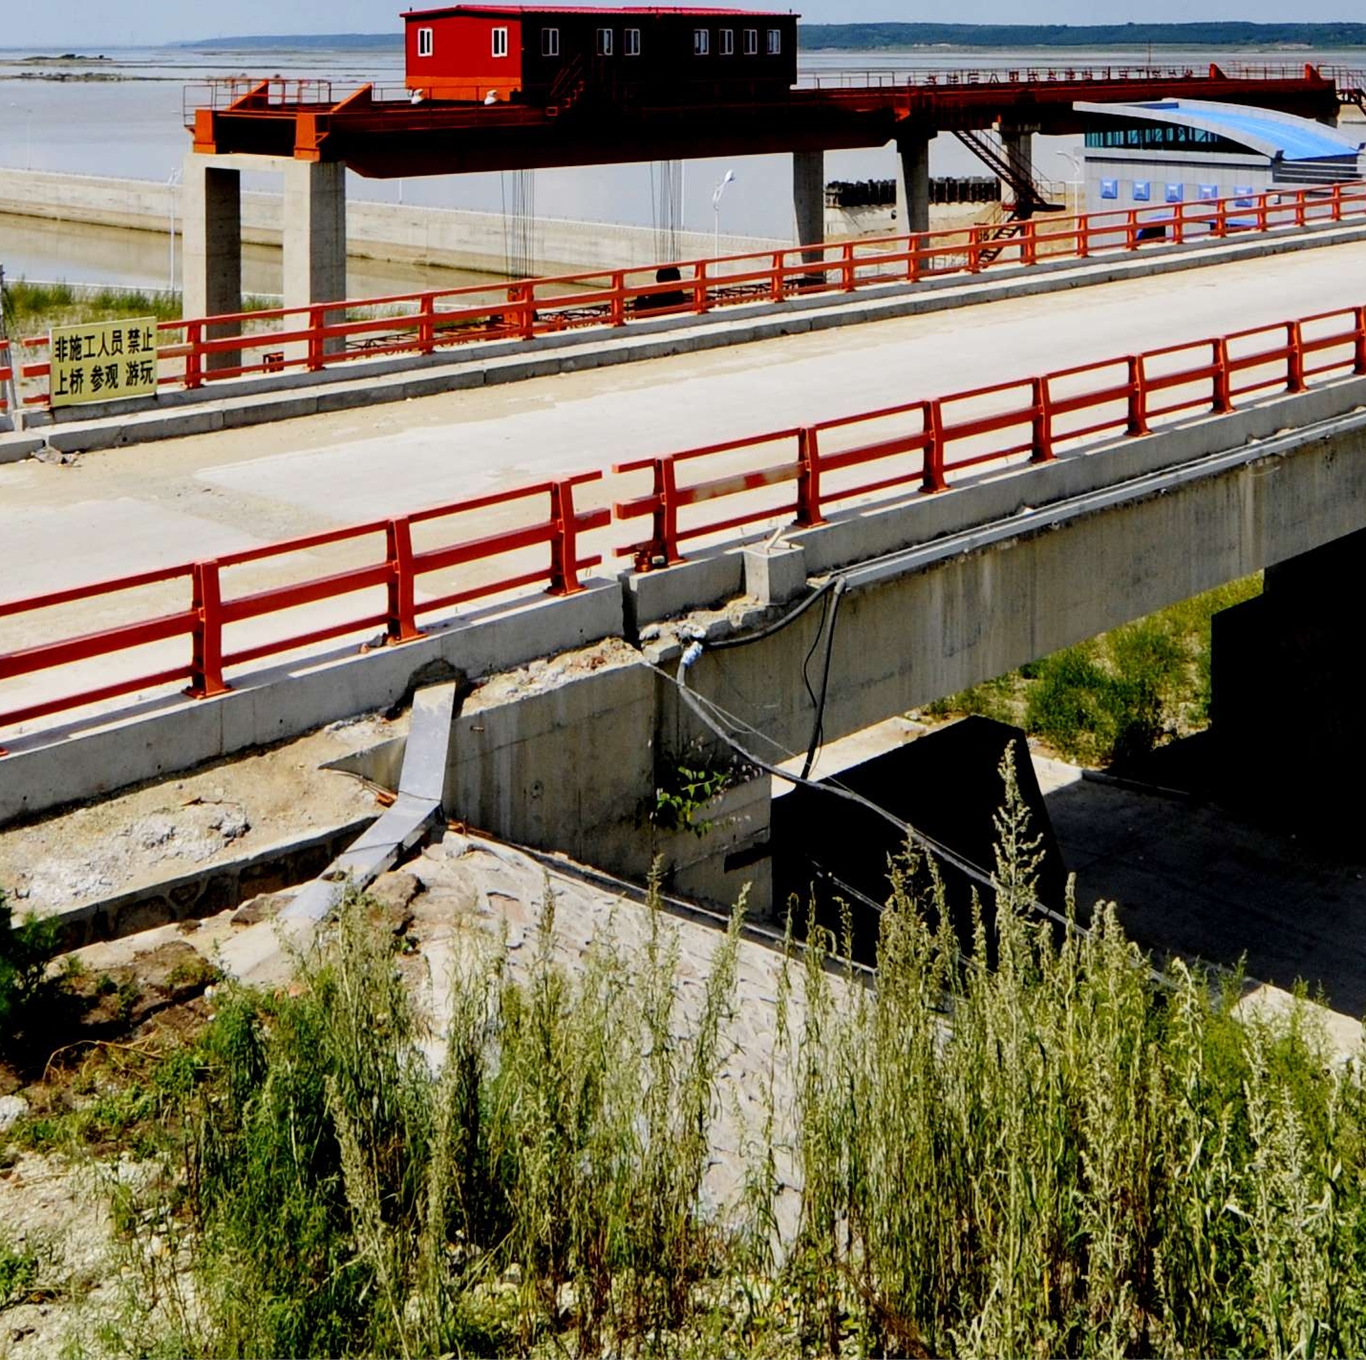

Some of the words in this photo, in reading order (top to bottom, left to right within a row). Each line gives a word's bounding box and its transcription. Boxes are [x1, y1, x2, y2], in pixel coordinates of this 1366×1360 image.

[54, 330, 124, 363] 非施工人员
[127, 326, 154, 355] 禁止
[54, 367, 84, 396] 上桥
[89, 363, 119, 393] 参观
[125, 358, 154, 387] 游玩
